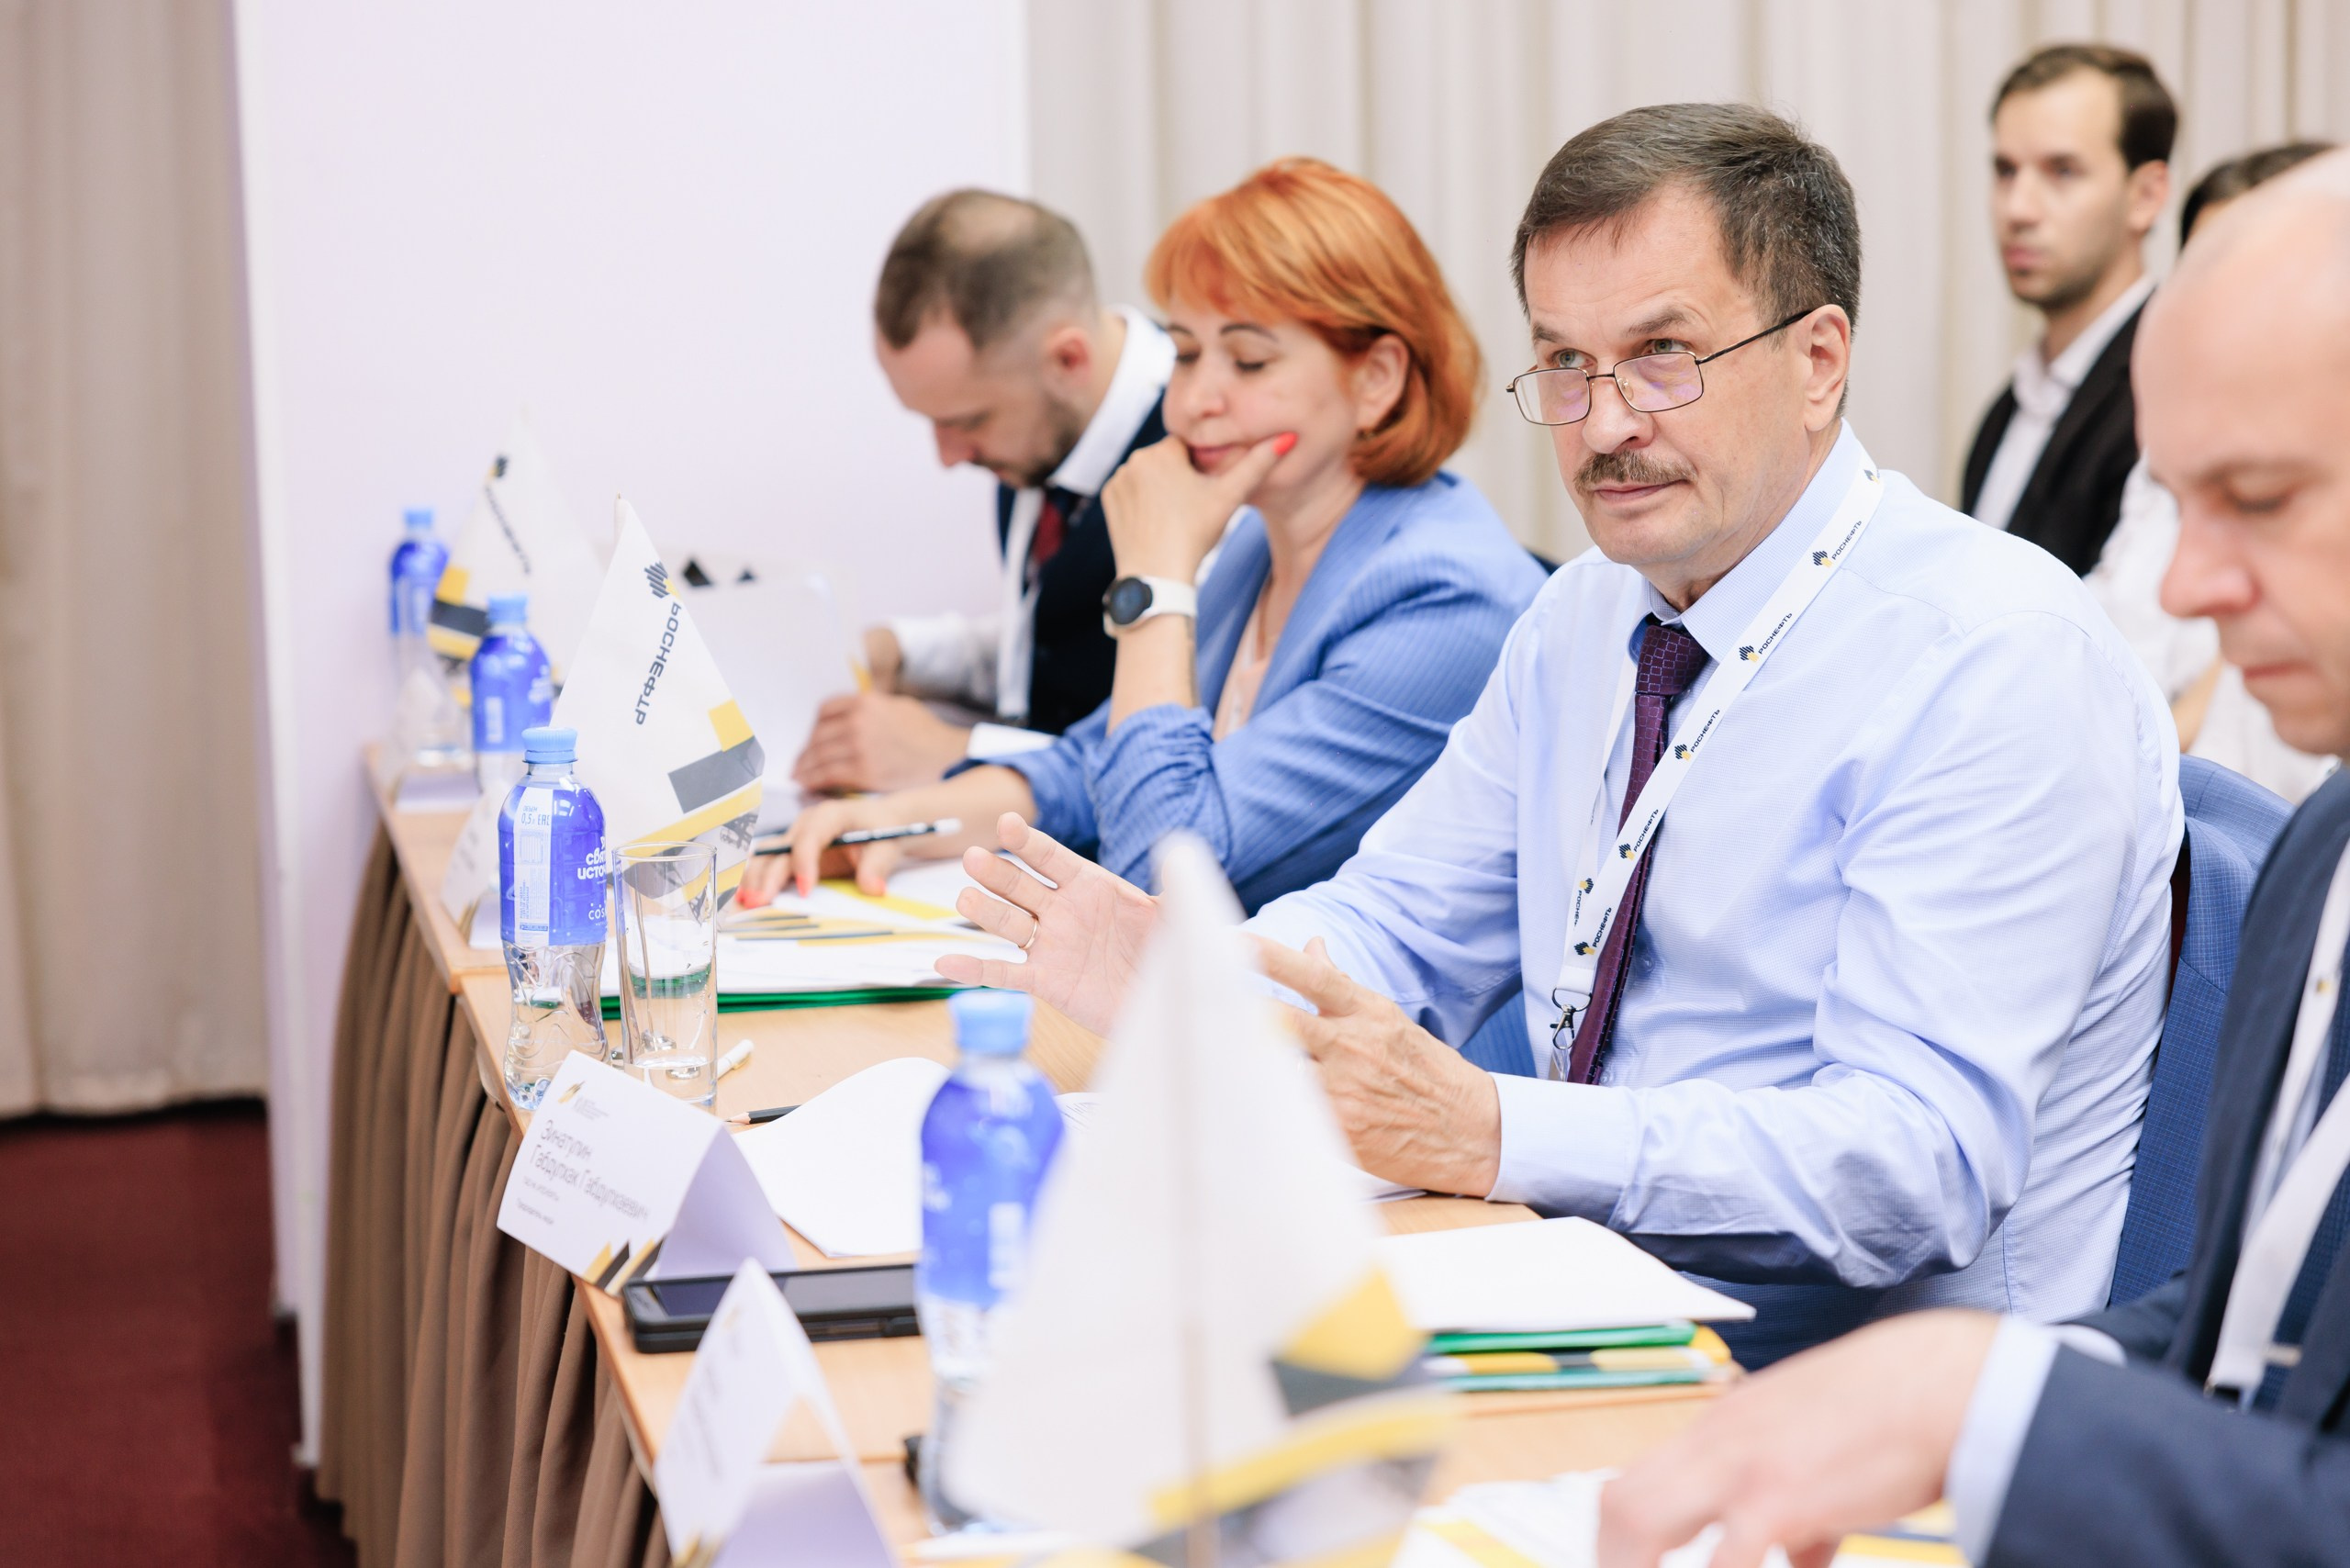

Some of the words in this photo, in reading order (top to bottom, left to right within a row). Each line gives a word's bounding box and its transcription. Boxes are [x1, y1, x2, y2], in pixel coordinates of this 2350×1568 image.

[1831, 521, 1863, 560] РОСНЕФТЬ
[1759, 612, 1793, 655] РОСНЕФТЬ
[1691, 709, 1720, 753] РОСНЕФТЬ
[1634, 809, 1659, 852] РОСНЕФТЬ
[1574, 890, 1583, 927] РОСНЕ
[1593, 908, 1612, 947] РОСНЕФТЬ
